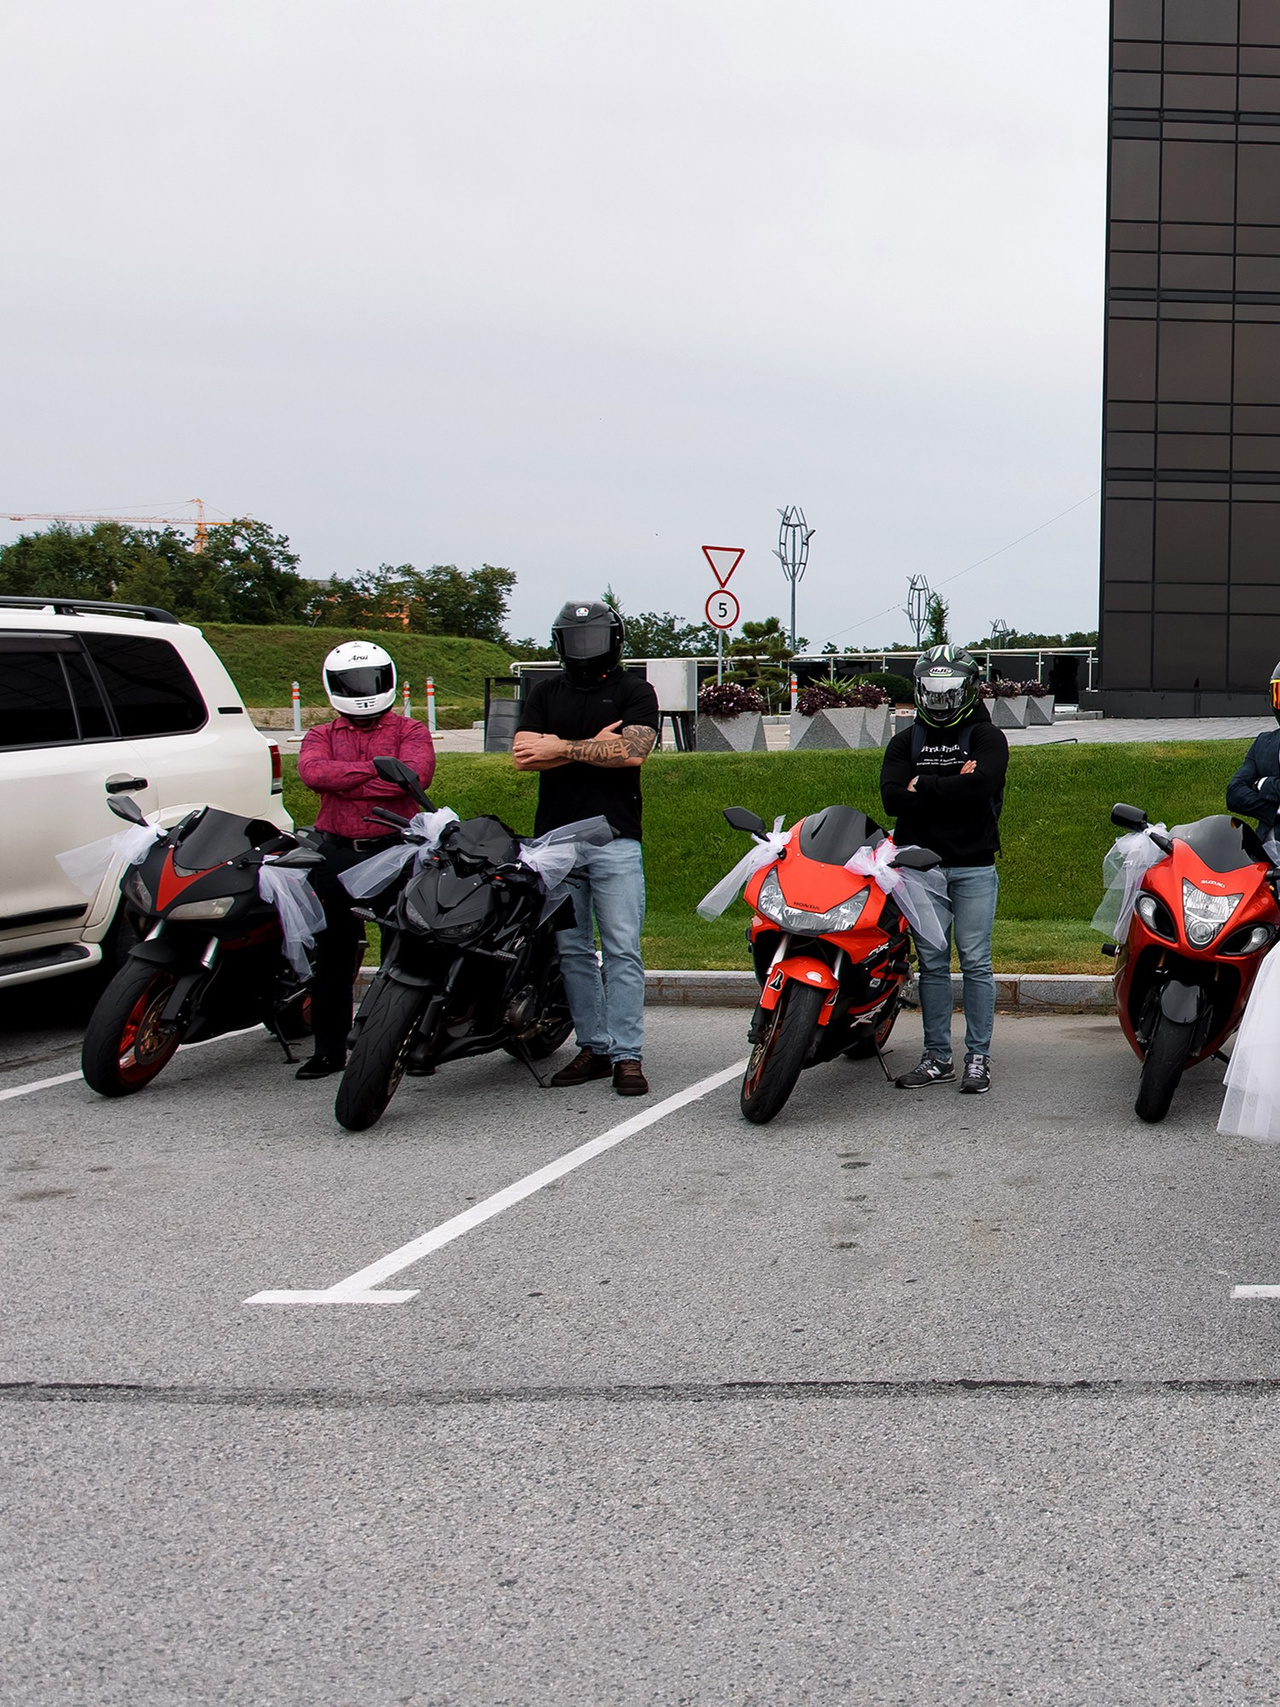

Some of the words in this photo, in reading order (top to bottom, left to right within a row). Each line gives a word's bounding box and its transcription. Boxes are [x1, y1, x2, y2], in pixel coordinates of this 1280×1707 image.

[718, 602, 728, 618] 5
[1200, 879, 1226, 888] SUZUKI
[793, 901, 820, 910] HONDA
